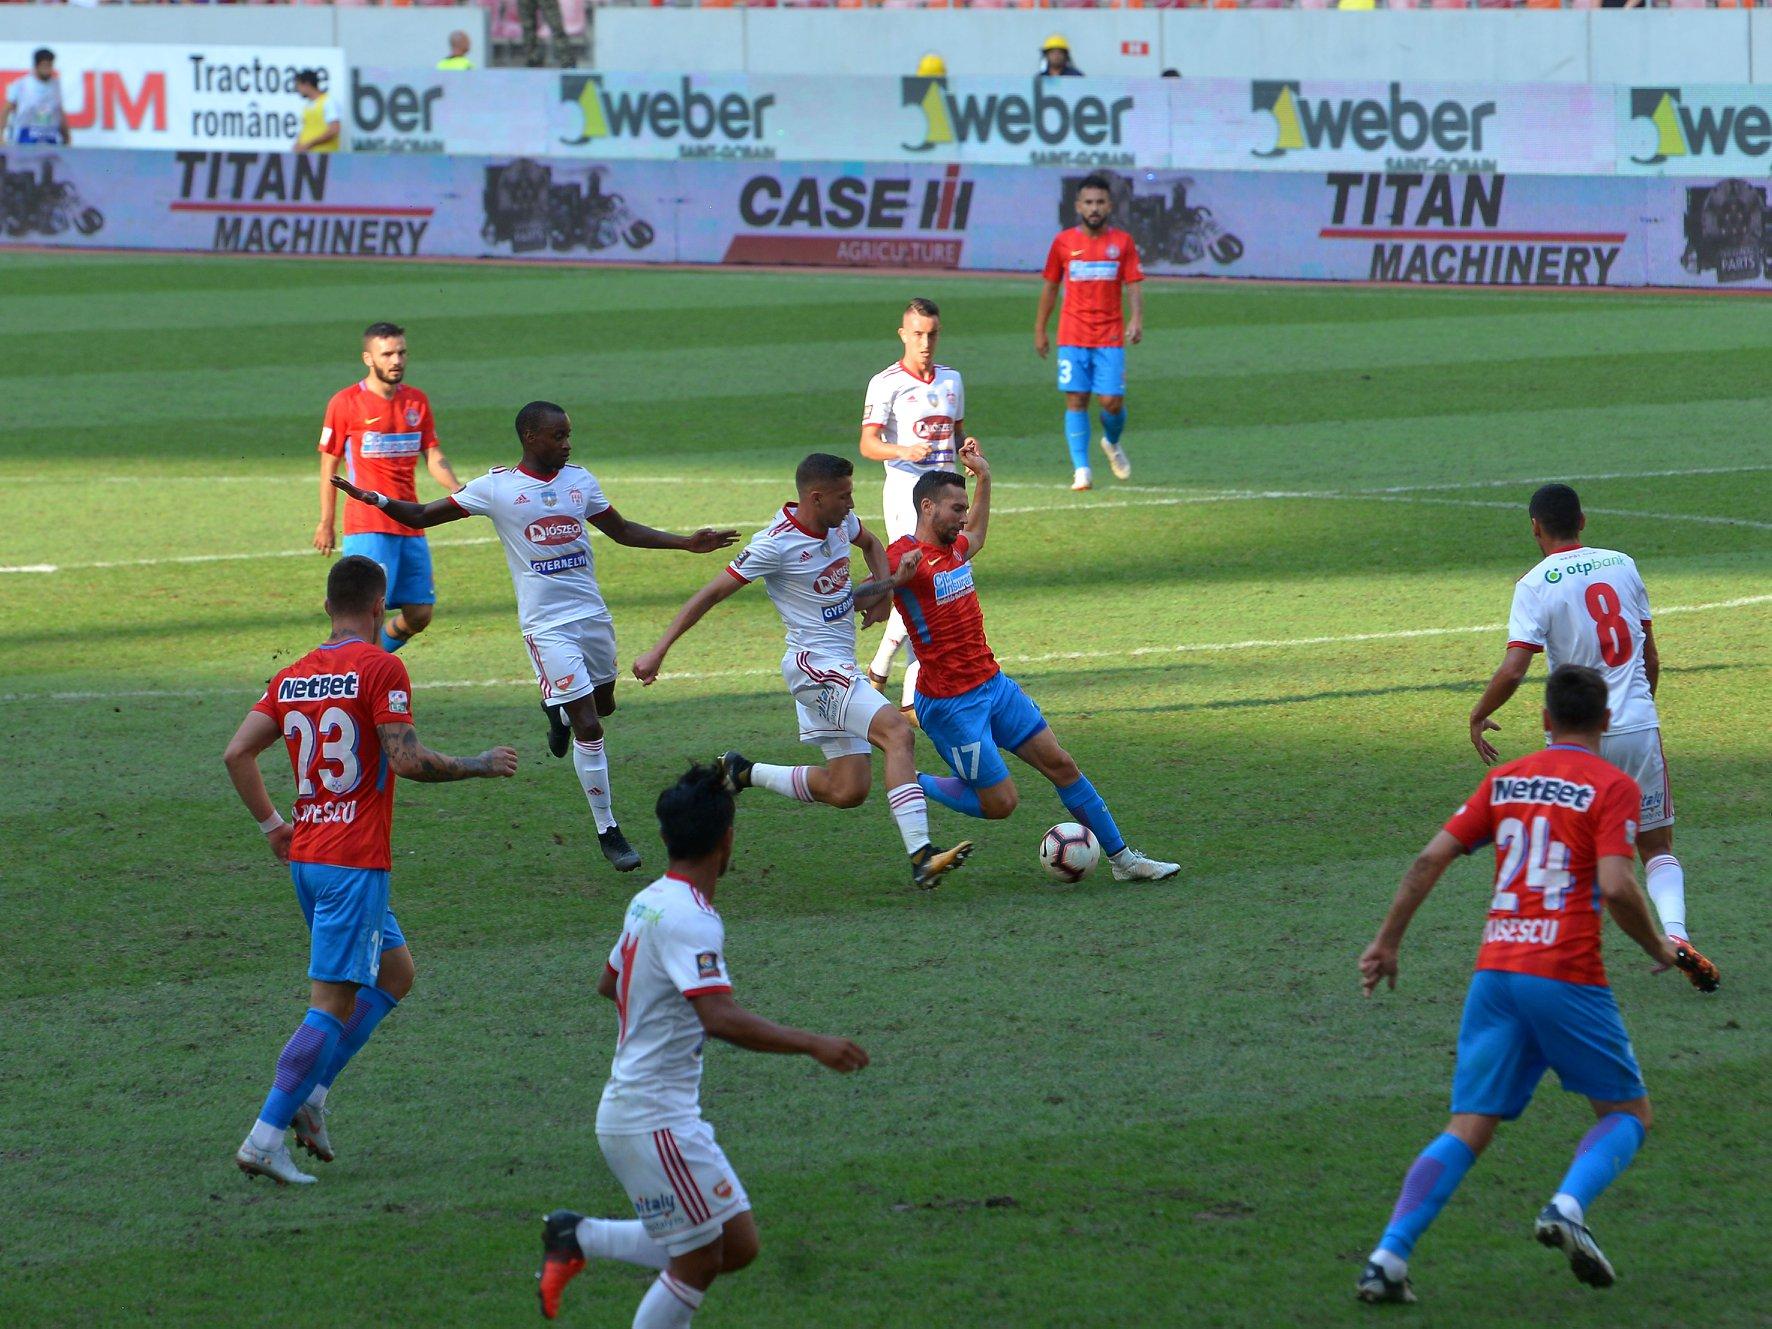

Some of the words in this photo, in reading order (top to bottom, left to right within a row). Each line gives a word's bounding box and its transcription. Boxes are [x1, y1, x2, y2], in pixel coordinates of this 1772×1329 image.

[190, 55, 329, 93] Tractoae
[192, 102, 297, 138] române
[602, 76, 776, 139] weber
[948, 76, 1134, 145] weber
[1297, 81, 1496, 152] weber
[175, 151, 329, 201] TITAN
[739, 175, 911, 229] CASE
[1326, 172, 1506, 227] TITAN
[213, 216, 429, 256] MACHINERY
[1369, 244, 1621, 285] MACHINERY
[1584, 582, 1633, 668] 8
[280, 674, 358, 699] NetBet
[284, 706, 361, 798] 23
[951, 741, 981, 780] 17
[1495, 778, 1592, 807] NetBet
[1491, 816, 1576, 913] 24
